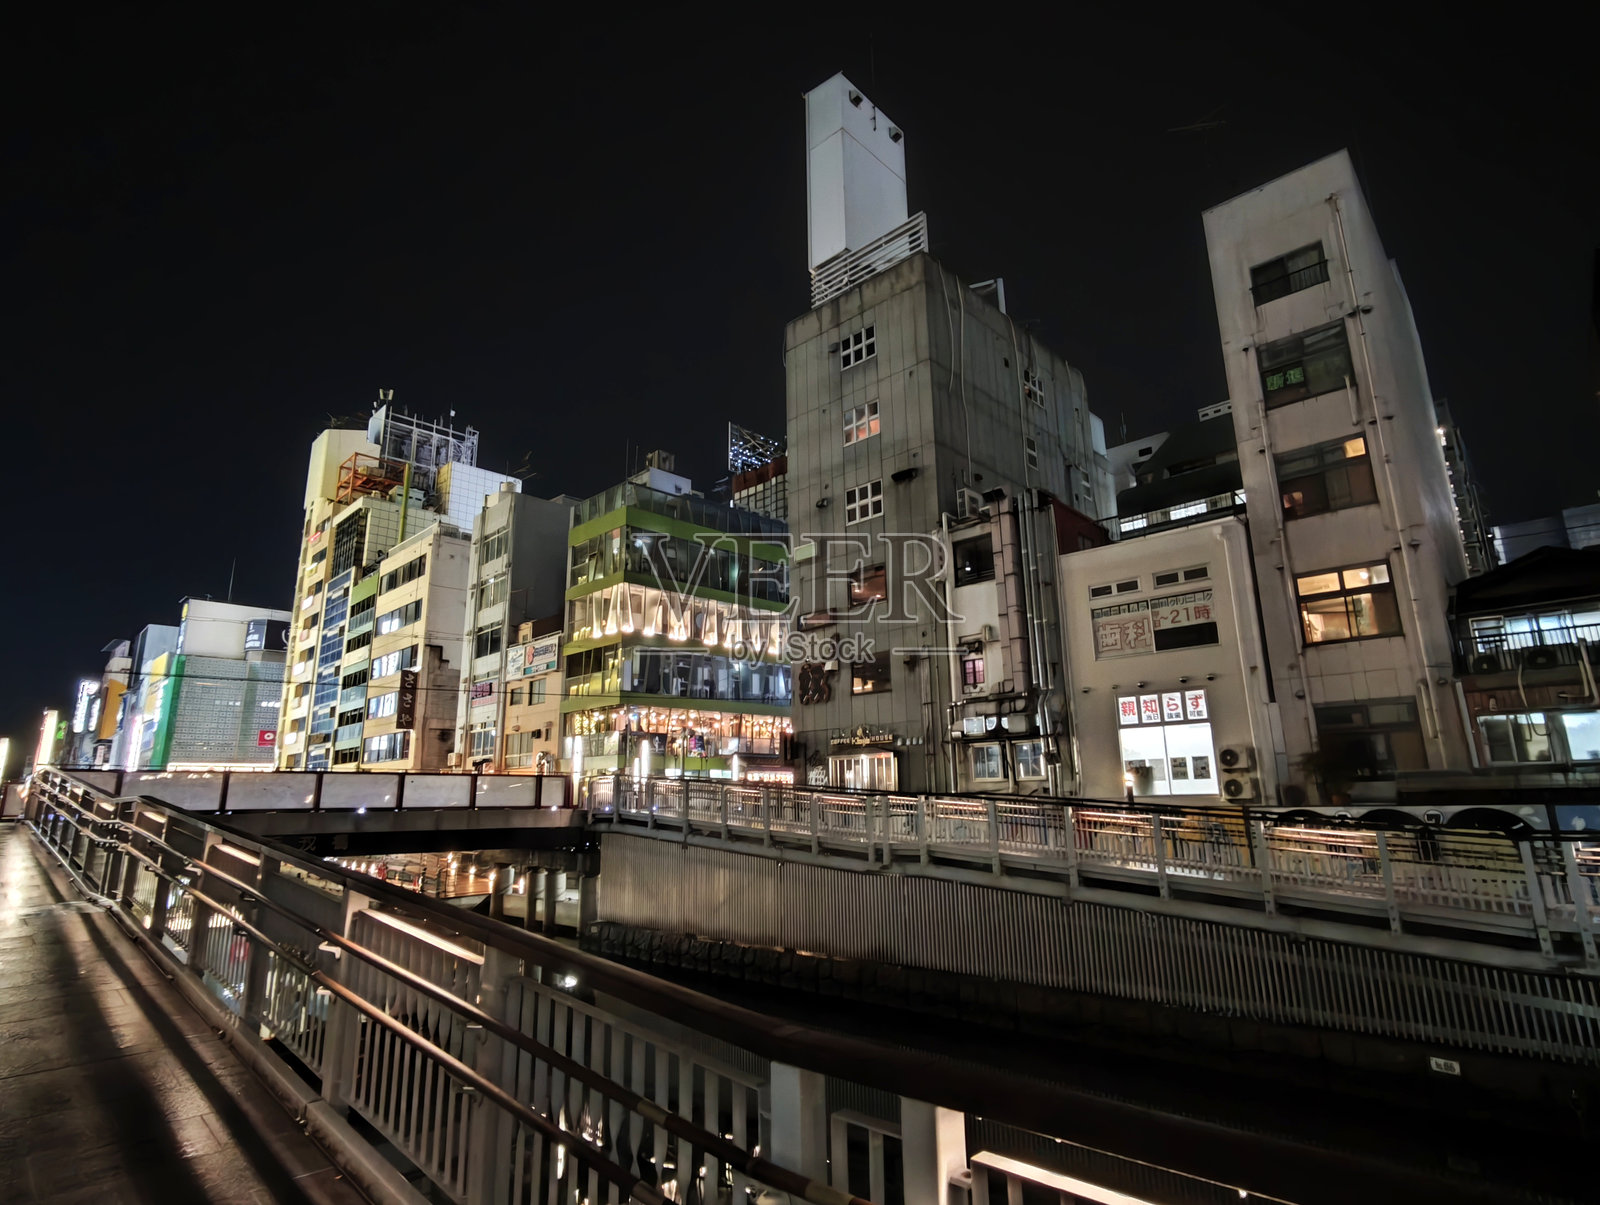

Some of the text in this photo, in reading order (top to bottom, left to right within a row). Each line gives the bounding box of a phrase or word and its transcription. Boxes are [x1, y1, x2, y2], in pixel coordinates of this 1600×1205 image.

[1097, 618, 1153, 653] 歯科
[1120, 694, 1204, 717] 親知らず
[830, 737, 850, 745] COFFEE
[871, 733, 893, 742] HOUSE
